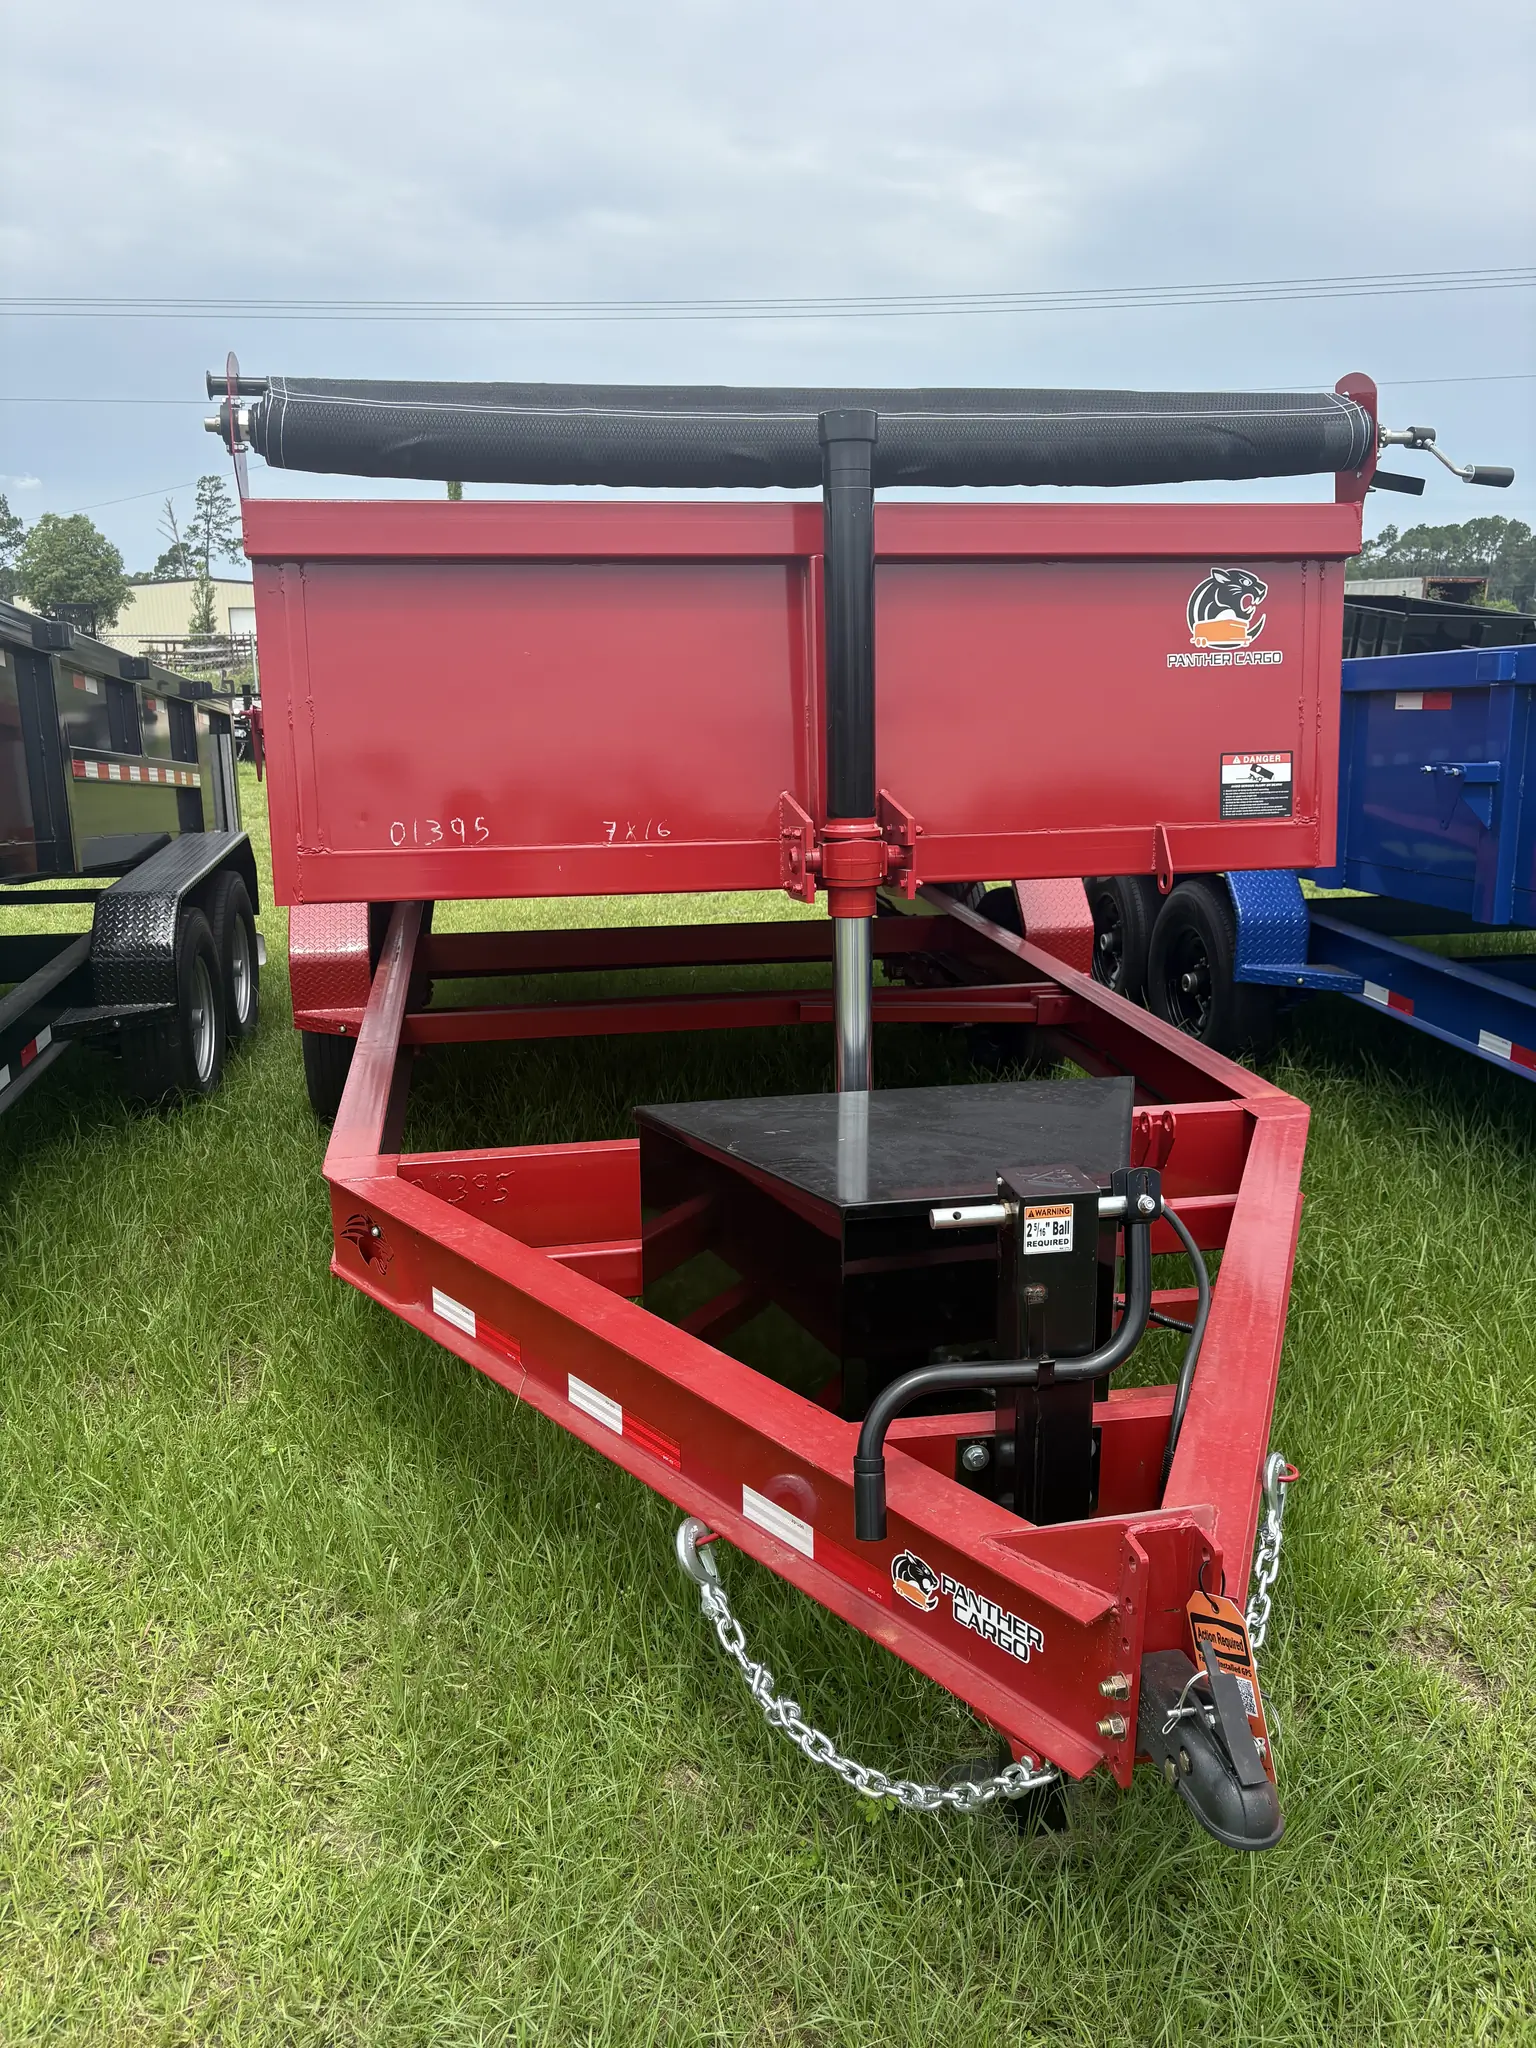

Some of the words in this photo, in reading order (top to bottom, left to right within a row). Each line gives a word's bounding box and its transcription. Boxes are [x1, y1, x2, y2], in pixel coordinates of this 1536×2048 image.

[1167, 652, 1232, 667] PANTHER
[1233, 651, 1283, 665] CARGO
[1243, 754, 1282, 764] DANGER
[390, 816, 490, 847] 01395
[1034, 1206, 1070, 1217] WARNING
[1052, 1220, 1070, 1236] Ball
[1026, 1238, 1070, 1248] REQUIRED
[940, 1572, 1044, 1653] PANTHER
[952, 1601, 1031, 1664] CARGO
[1198, 1627, 1217, 1643] Action
[1218, 1632, 1244, 1651] Required
[1241, 1668, 1252, 1678] GPS
